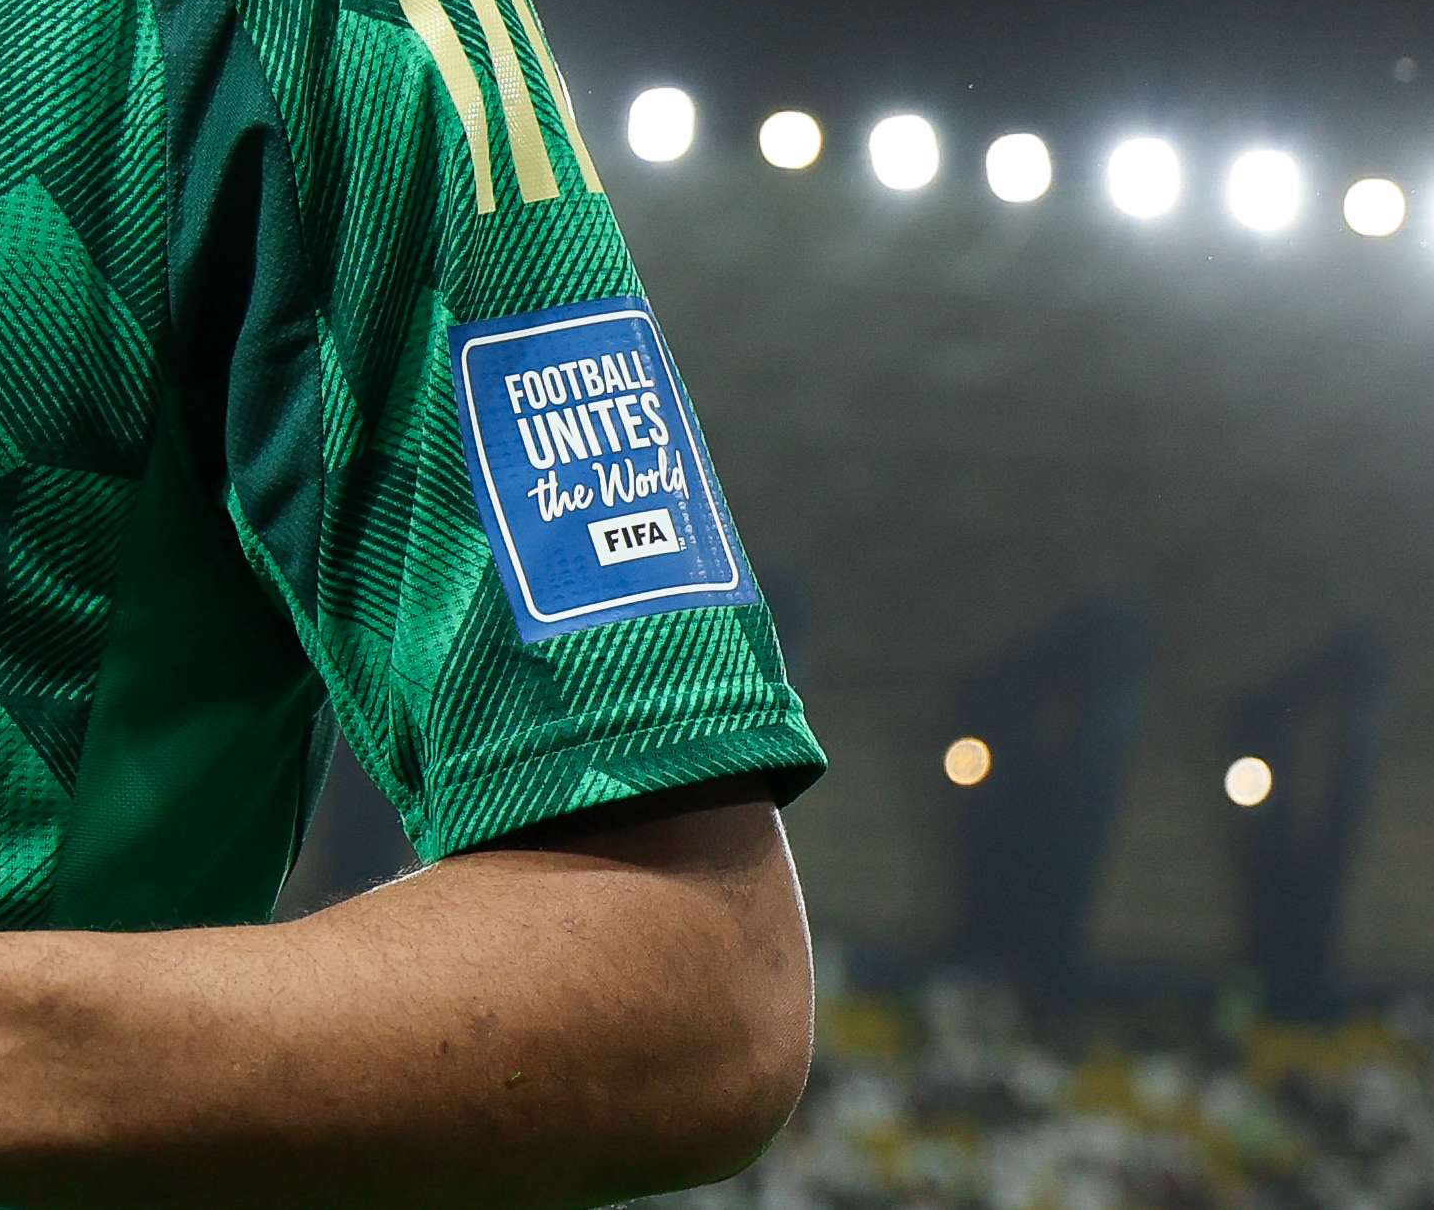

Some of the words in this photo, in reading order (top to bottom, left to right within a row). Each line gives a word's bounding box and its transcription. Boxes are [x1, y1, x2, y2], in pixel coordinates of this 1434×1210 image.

[505, 350, 654, 414] FOOTBALL
[517, 391, 669, 469] UNITES
[528, 470, 595, 522] the
[592, 447, 689, 508] World
[603, 521, 667, 553] FIFA
